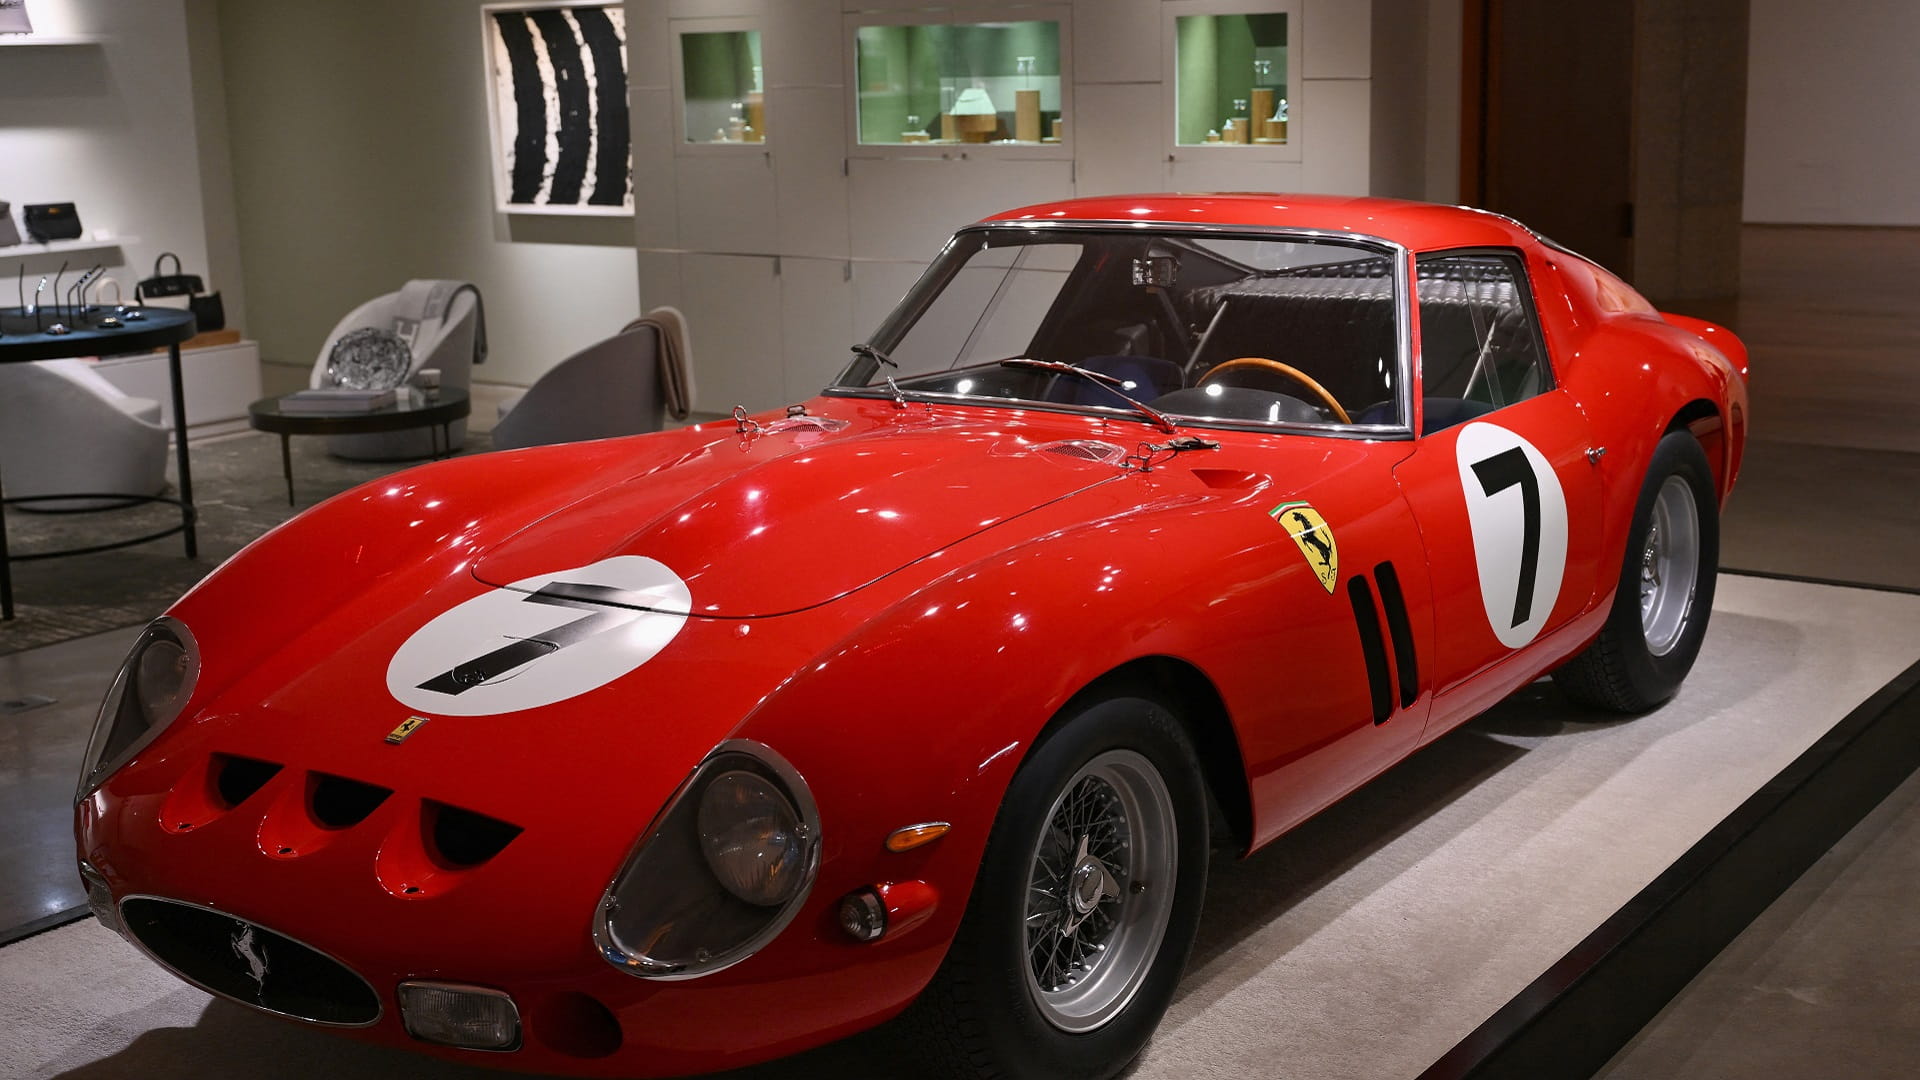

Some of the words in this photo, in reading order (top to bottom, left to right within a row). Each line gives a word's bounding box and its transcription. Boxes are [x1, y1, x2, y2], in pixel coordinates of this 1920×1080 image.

[1321, 571, 1327, 585] S
[1470, 446, 1541, 629] 7
[415, 581, 667, 696] 7
